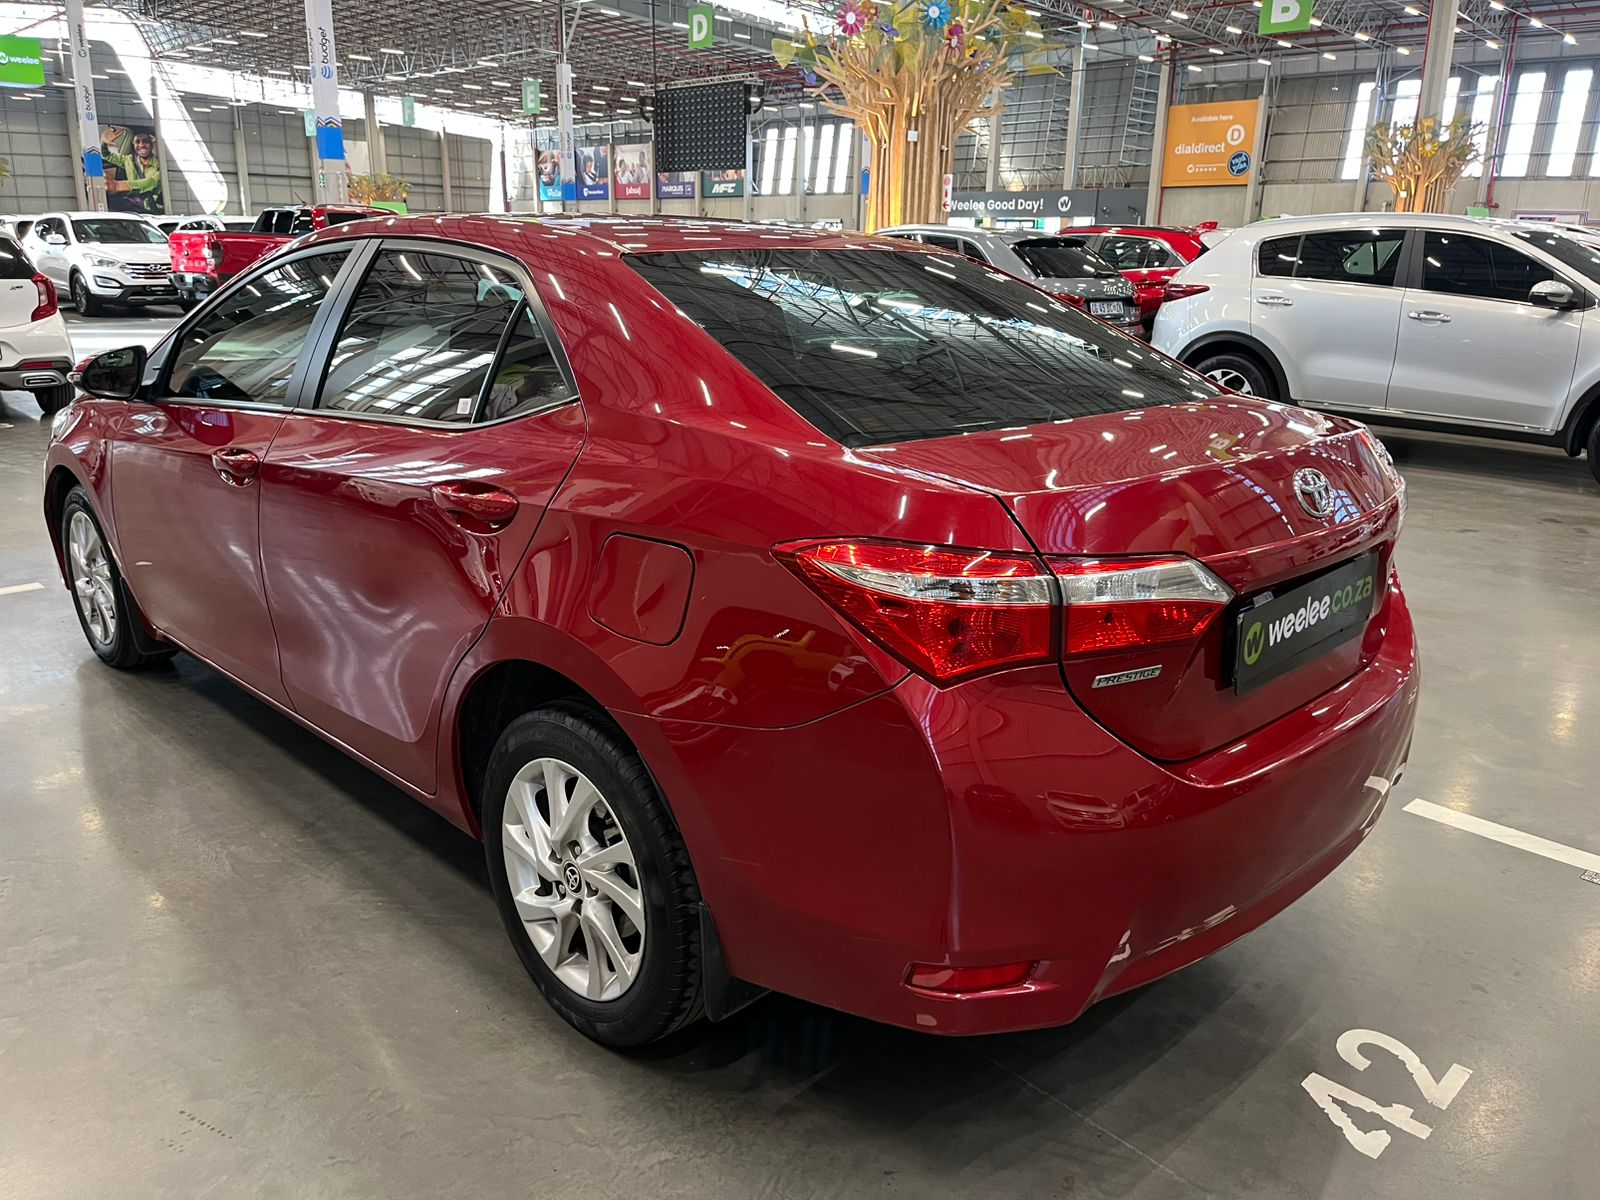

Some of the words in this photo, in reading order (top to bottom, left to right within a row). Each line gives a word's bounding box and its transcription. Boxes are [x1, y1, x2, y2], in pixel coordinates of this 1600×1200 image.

[692, 14, 708, 41] D
[318, 27, 330, 64] budget
[9, 56, 40, 65] weelee
[83, 85, 93, 111] budget
[527, 88, 535, 108] E
[1174, 142, 1226, 155] dialdirect
[711, 183, 736, 193] MFC
[951, 199, 985, 211] Weelee
[987, 199, 1015, 210] Good
[1017, 198, 1044, 213] Day!
[1096, 667, 1160, 686] PRESTIGE
[1301, 1029, 1473, 1159] 42
